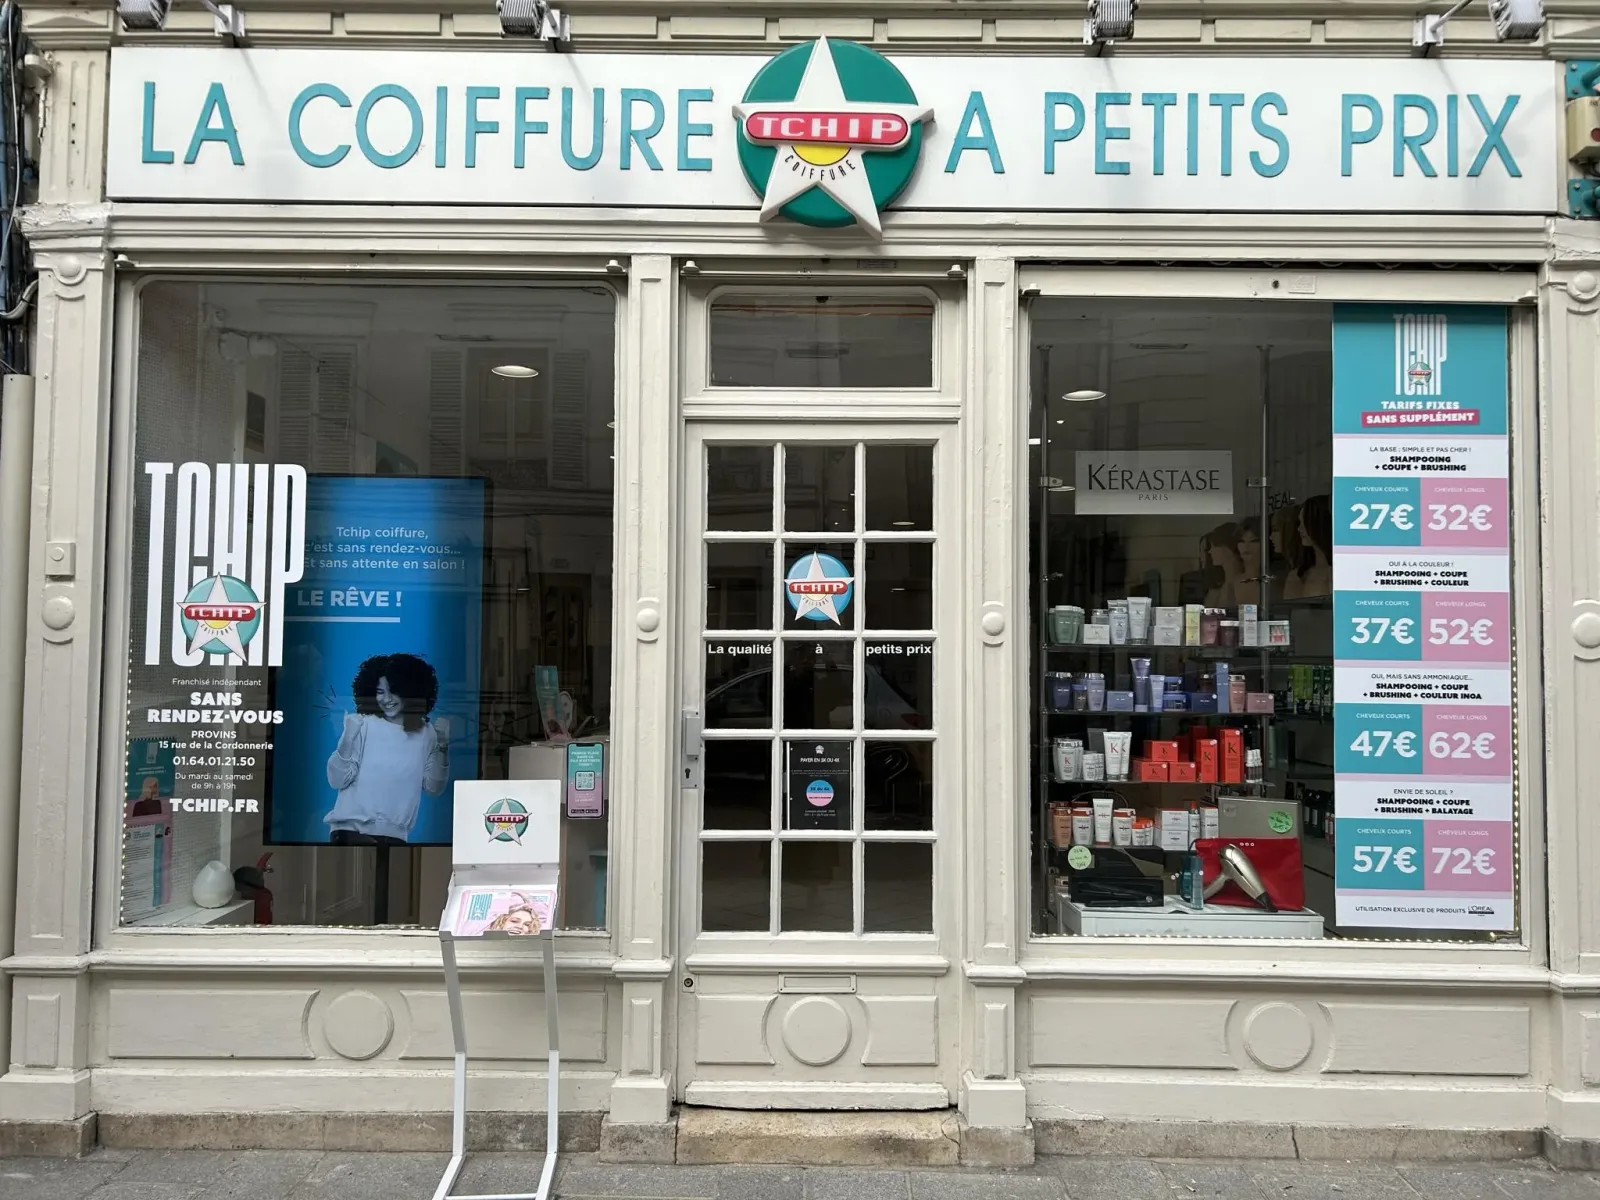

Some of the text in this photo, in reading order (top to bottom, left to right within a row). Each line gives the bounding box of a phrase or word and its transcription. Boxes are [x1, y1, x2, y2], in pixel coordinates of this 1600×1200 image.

[141, 81, 714, 171] LA COIFFURE
[757, 117, 902, 140] TCHIP
[943, 91, 1522, 178] A PETITS PRIX
[784, 155, 856, 181] COIFFURE
[1381, 401, 1460, 410] TARIFS FIXES
[1366, 411, 1475, 424] SANS SUPPLÉMENT
[1088, 463, 1220, 490] KÉRASTASE
[1350, 503, 1415, 530] 27€
[1427, 504, 1493, 531] 32€
[336, 526, 429, 540] Tchip coiffure,
[336, 544, 366, 553] sans
[369, 543, 461, 554] rendez-vous...
[319, 559, 348, 568] sans
[351, 558, 399, 569] attente
[403, 561, 419, 569] en
[422, 559, 457, 570] salon
[1375, 570, 1432, 578] SHAMPOOING
[791, 582, 845, 592] TCHIP
[297, 586, 402, 607] LE RÊVE !
[188, 607, 251, 618] TCHIP
[1351, 617, 1415, 644] 37€
[1428, 618, 1494, 645] 52€
[708, 644, 932, 657] La qualité à petits prix
[172, 678, 262, 688] Franchisé indépendant
[190, 692, 242, 706] SANS
[147, 709, 284, 724] RENDEZ-VOUS
[191, 730, 237, 739] PROVINS
[158, 740, 169, 749] 15
[189, 741, 201, 750] de
[204, 741, 212, 750] la
[215, 741, 274, 750] Cordonnerie
[1350, 730, 1417, 758] 47€
[1428, 731, 1496, 759] 62€
[172, 756, 255, 766] 01.64.01.21.50
[175, 772, 187, 781] Du
[188, 772, 211, 781] mardi
[225, 773, 253, 781] samedi
[191, 782, 236, 790] de 9h à 19h
[169, 798, 259, 813] TCHIP.FR
[1380, 806, 1423, 814] BRUSHING
[1431, 807, 1473, 815] BALAYAGE
[1353, 846, 1417, 874] 57€
[1431, 847, 1496, 875] 72€
